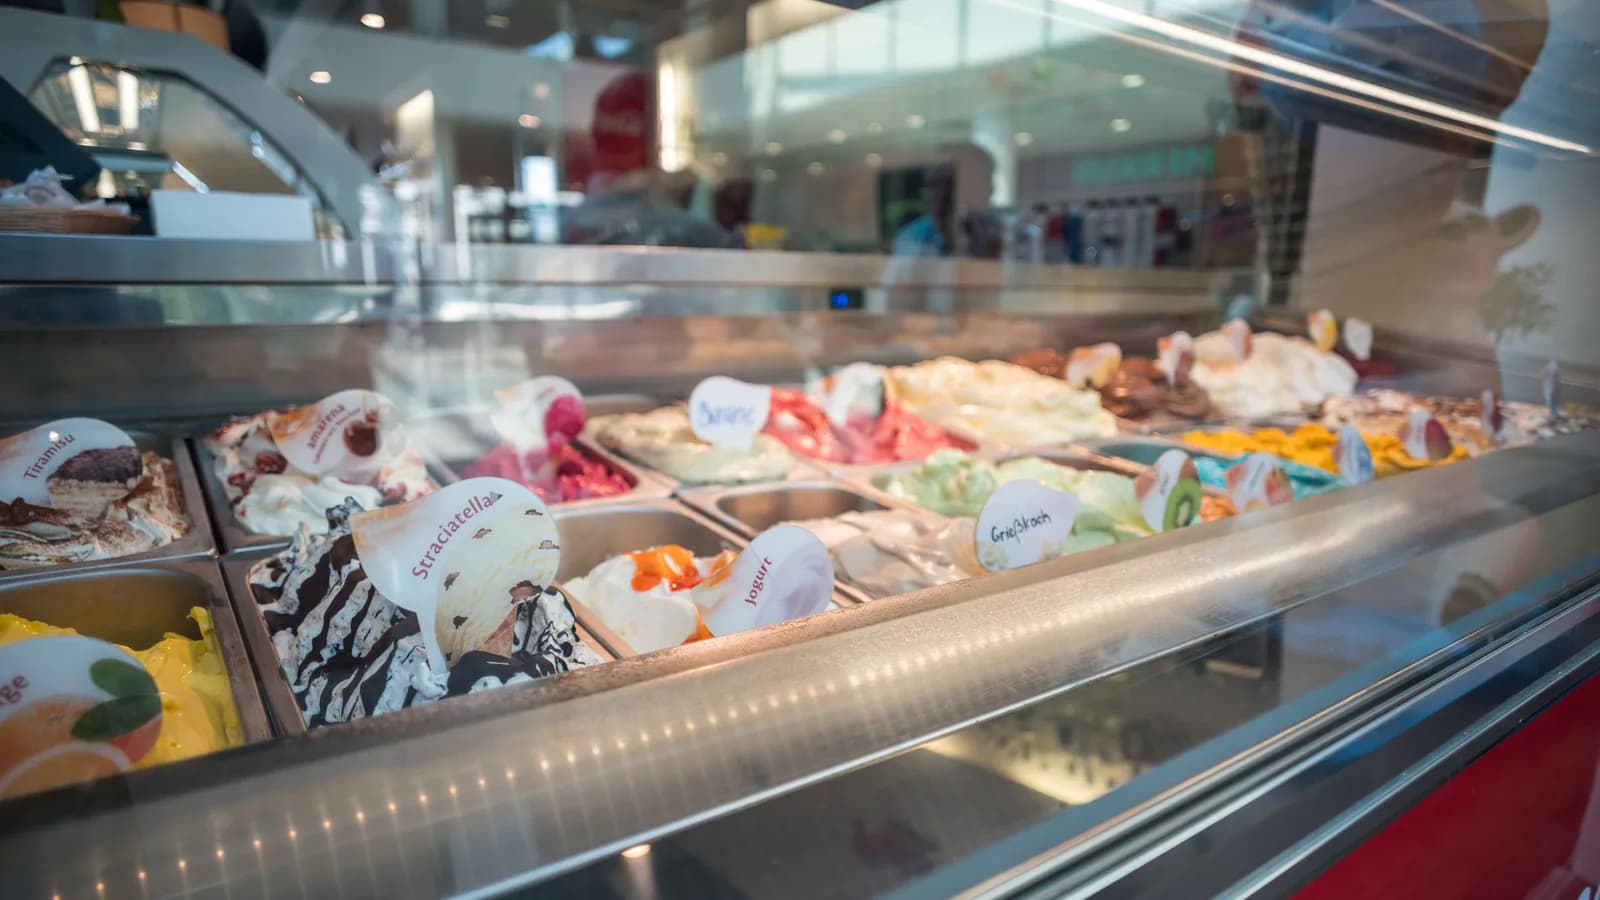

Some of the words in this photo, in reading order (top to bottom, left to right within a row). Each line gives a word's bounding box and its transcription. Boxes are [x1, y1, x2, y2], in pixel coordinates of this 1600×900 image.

[24, 433, 75, 480] Tiramisu
[412, 495, 494, 580] Straciatella
[744, 556, 773, 606] Jogurt
